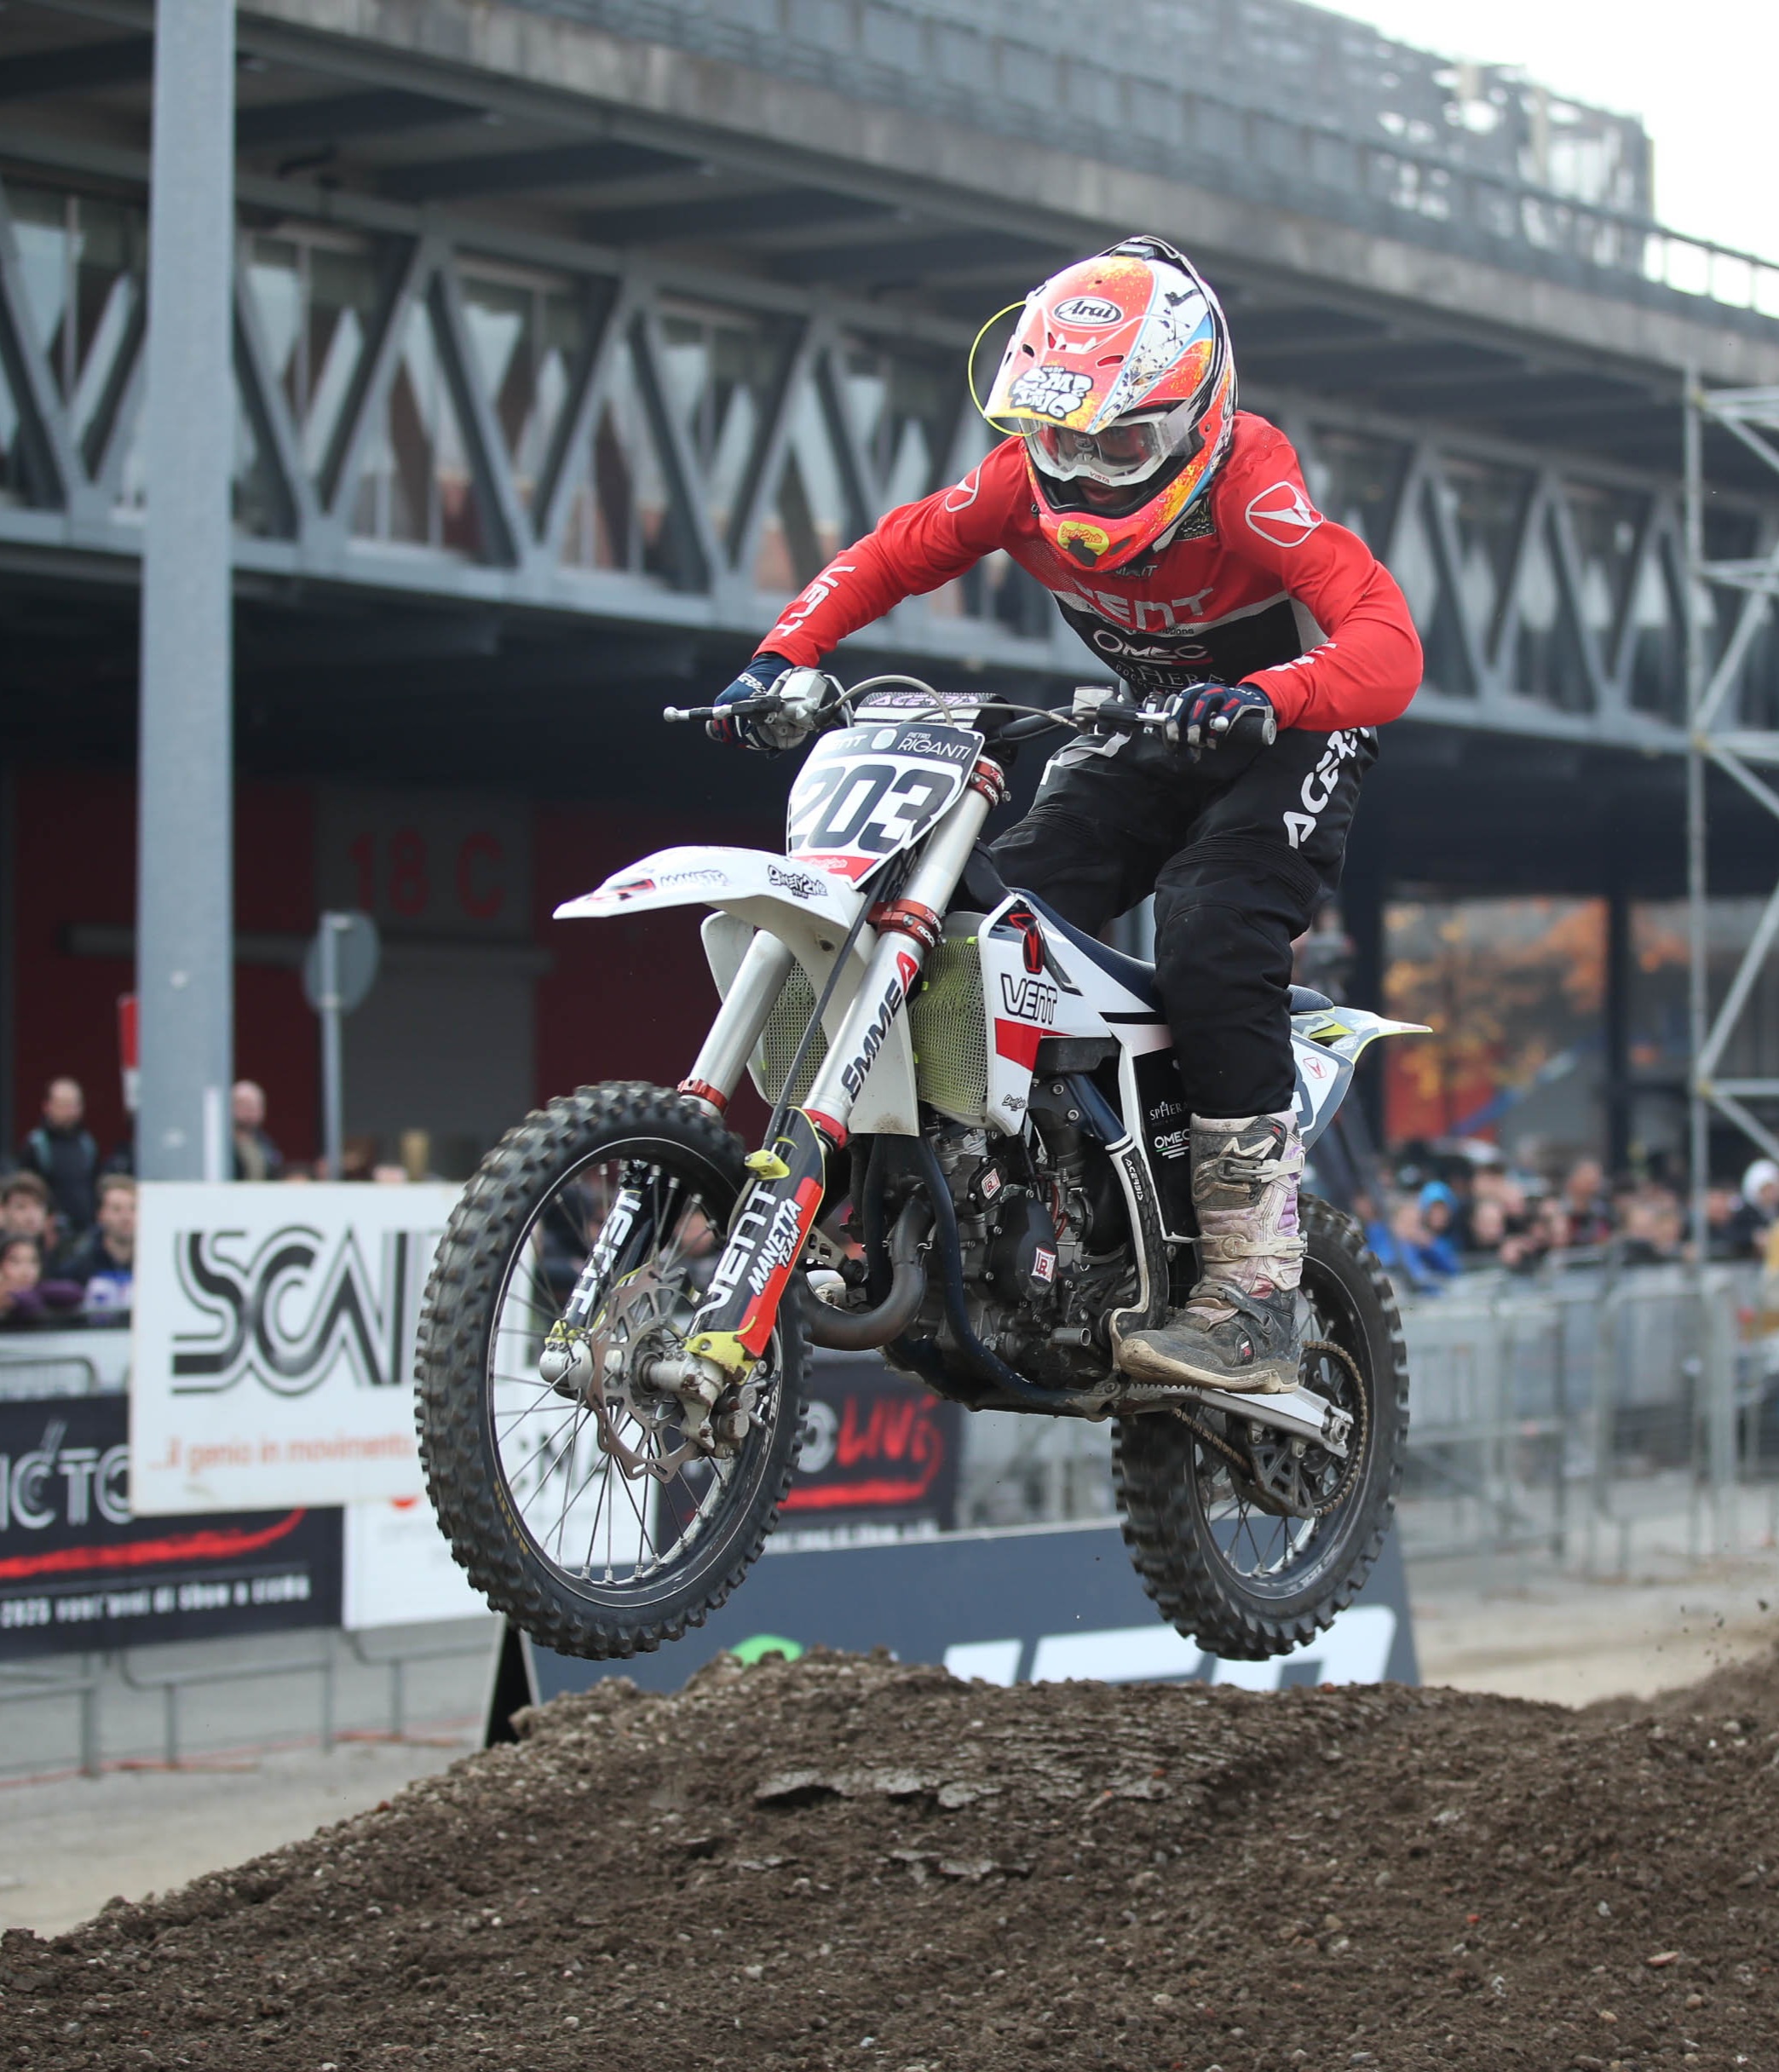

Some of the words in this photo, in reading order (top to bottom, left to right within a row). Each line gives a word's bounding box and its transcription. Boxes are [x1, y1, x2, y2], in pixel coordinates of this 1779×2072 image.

[1058, 300, 1114, 319] Arai
[896, 738, 973, 761] RIGANTI
[788, 764, 956, 855] 203
[350, 830, 429, 917] 18
[457, 831, 505, 918] C
[1000, 972, 1057, 1025] VENT
[692, 1181, 777, 1321] VENT
[747, 1198, 803, 1296] MANETTA
[777, 1223, 802, 1268] TEAM
